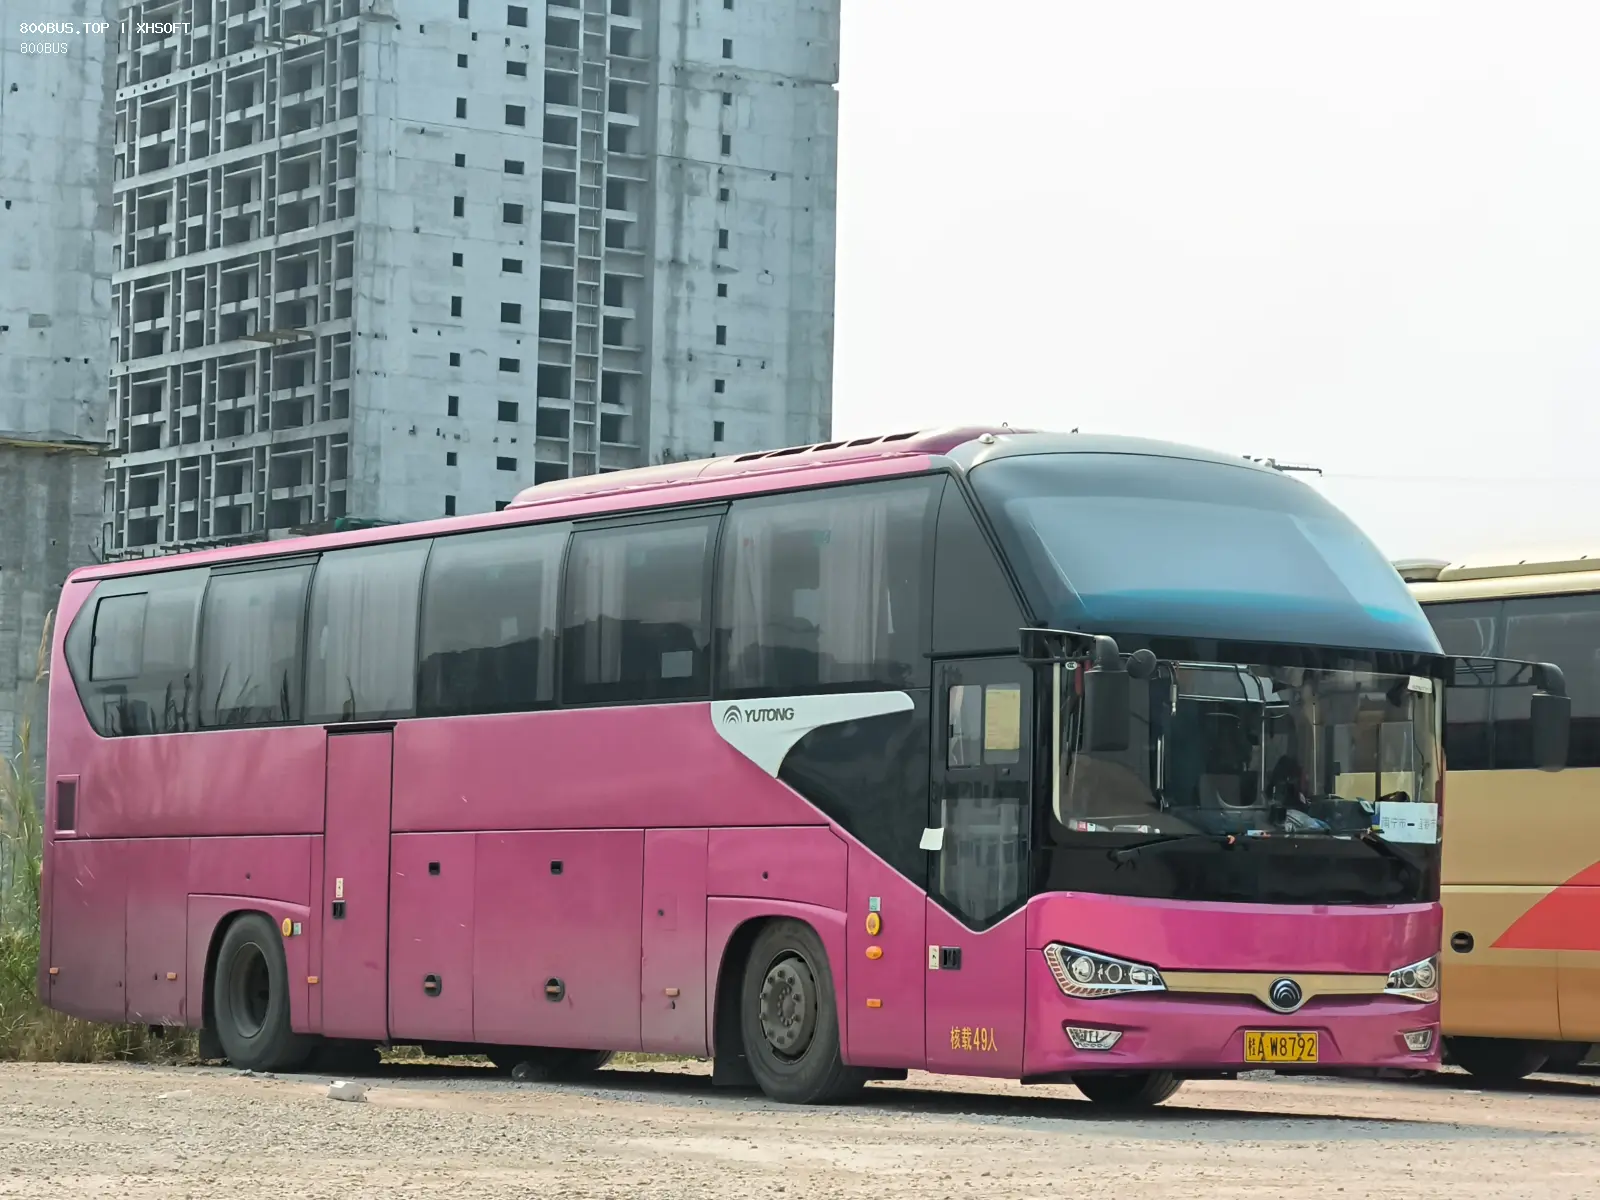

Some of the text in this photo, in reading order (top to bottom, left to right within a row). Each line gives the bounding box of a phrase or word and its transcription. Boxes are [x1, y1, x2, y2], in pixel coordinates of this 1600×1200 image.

[744, 707, 795, 723] YUTONG
[950, 1025, 998, 1052] 核载49人
